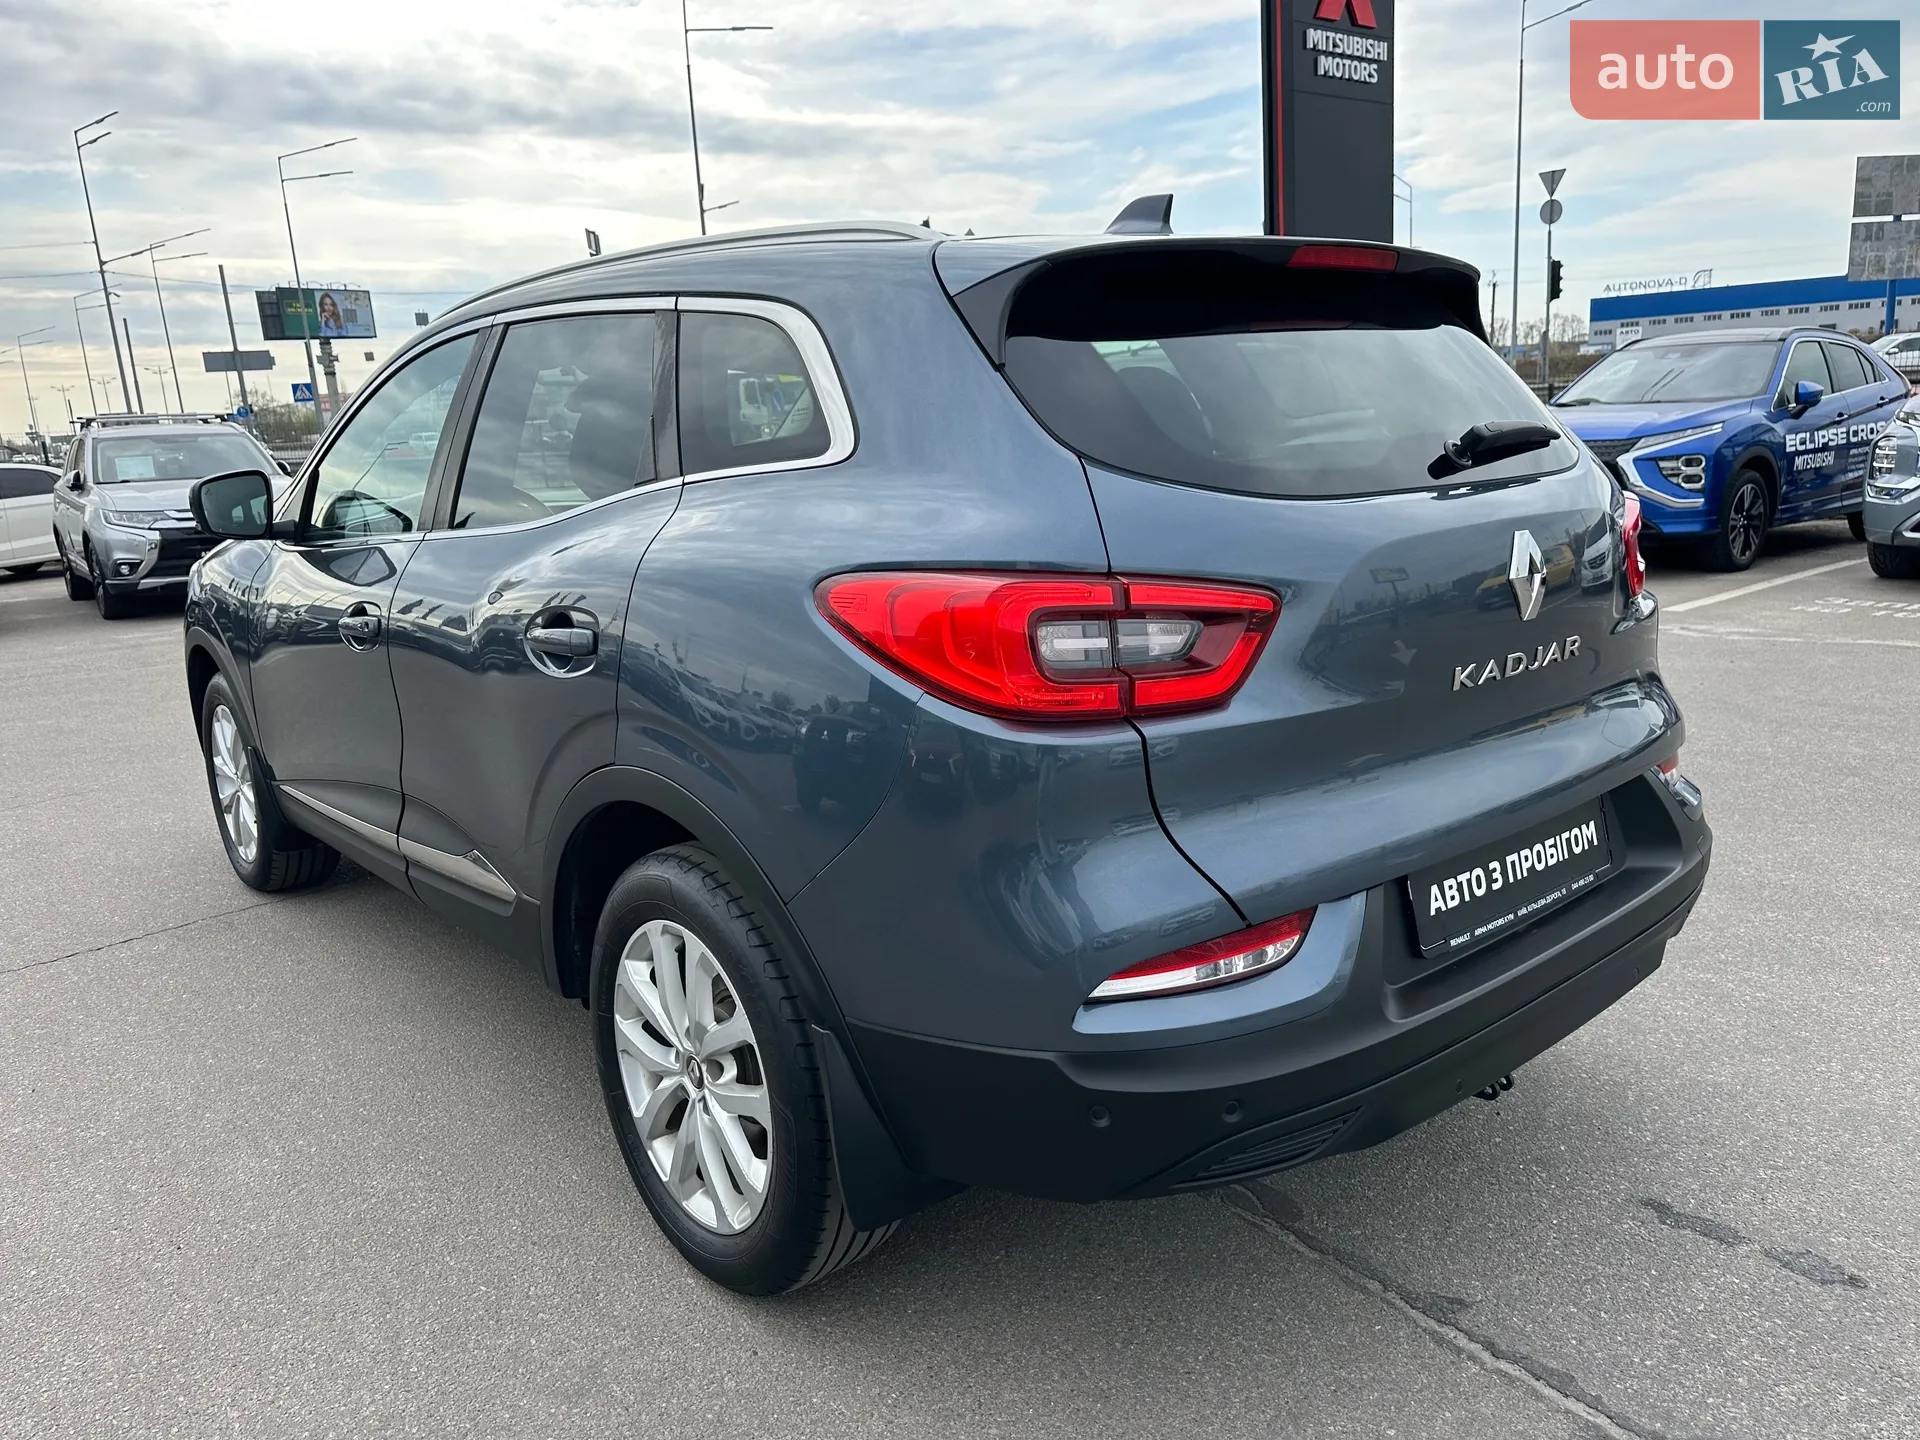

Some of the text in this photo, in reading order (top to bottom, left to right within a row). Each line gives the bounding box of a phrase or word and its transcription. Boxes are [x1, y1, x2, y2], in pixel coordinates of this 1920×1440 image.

[1305, 28, 1388, 62] MITSUBISHI
[1316, 55, 1379, 84] MOTORS
[1603, 276, 1688, 293] AUTONOVA-D
[1785, 426, 1847, 453] ECLIPSE
[1793, 450, 1836, 471] MITSUBISHI
[1452, 634, 1582, 692] KADJAR
[1429, 867, 1488, 917] АВТО
[1505, 820, 1598, 883] ПРОБІГОМ
[1450, 932, 1471, 947] RENAULT
[1474, 925, 1488, 937] ARMA
[1486, 916, 1505, 931] MOTORS
